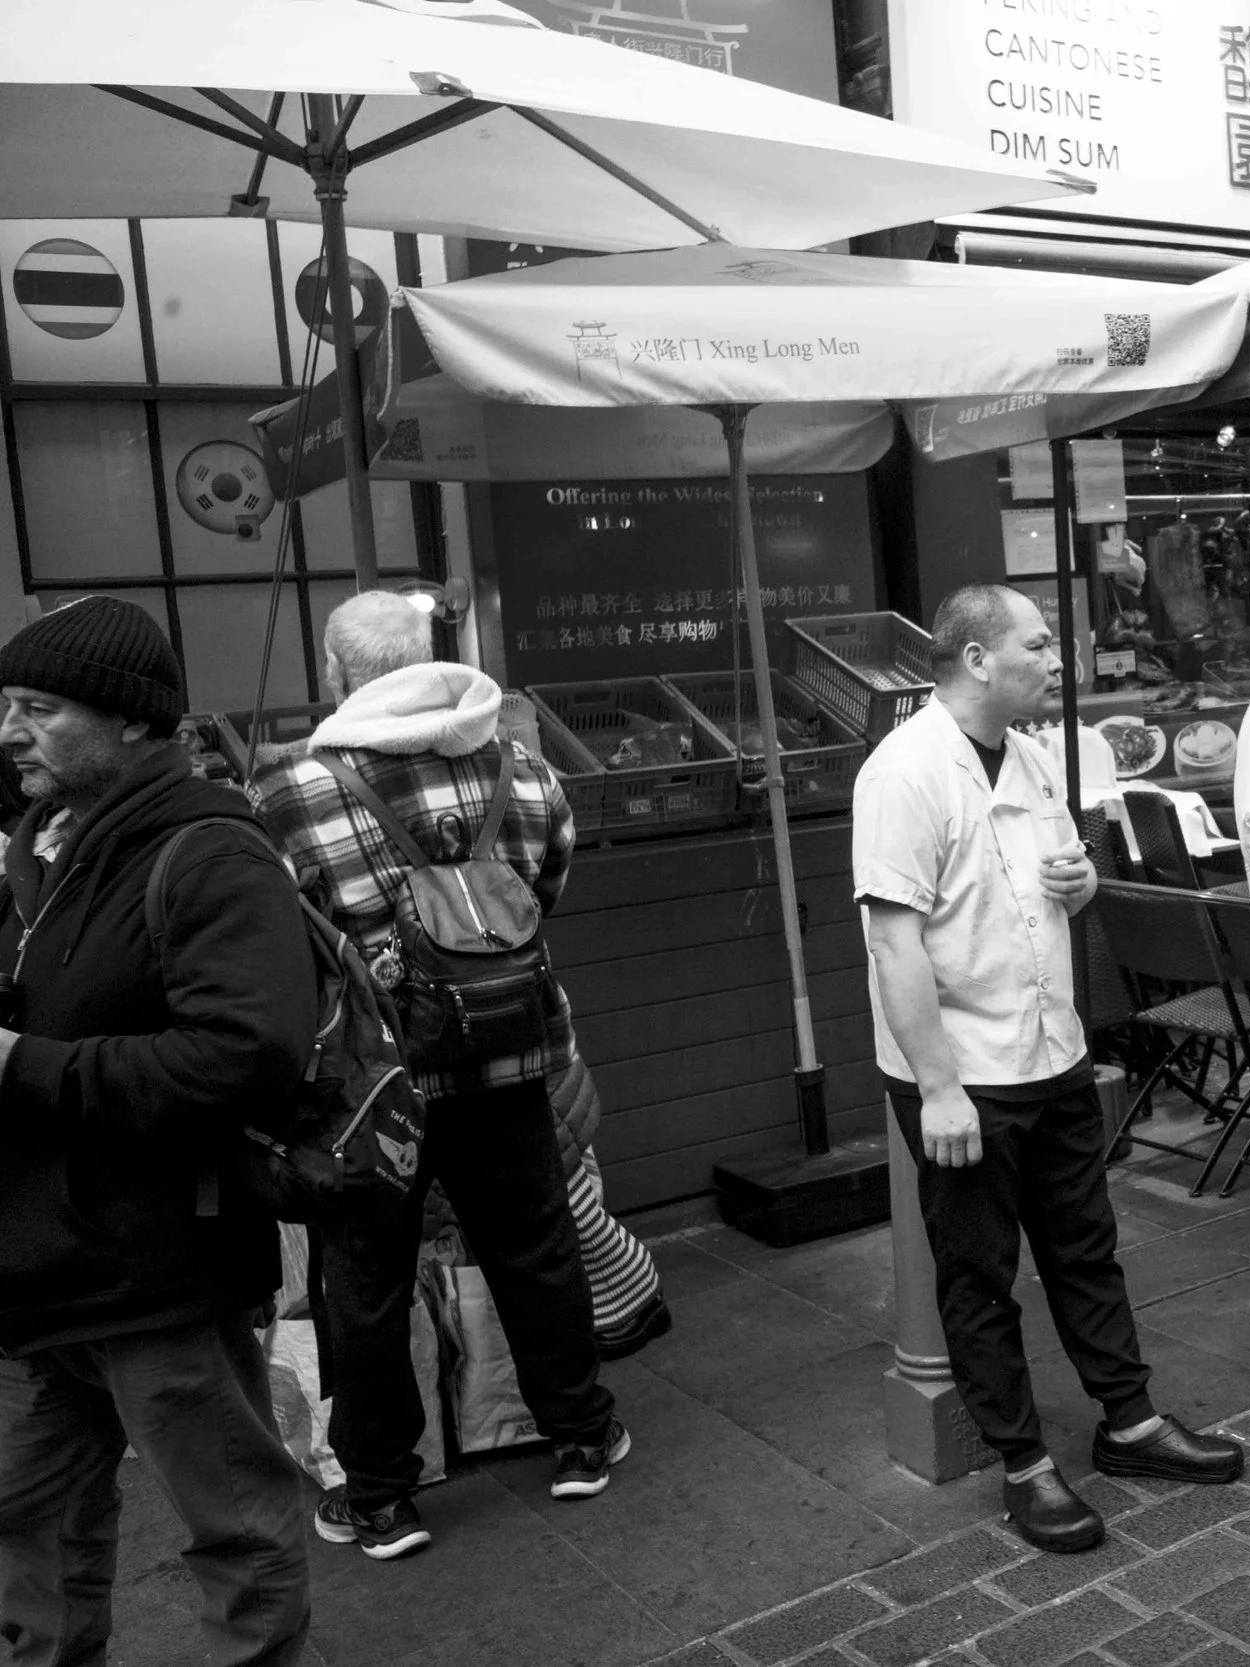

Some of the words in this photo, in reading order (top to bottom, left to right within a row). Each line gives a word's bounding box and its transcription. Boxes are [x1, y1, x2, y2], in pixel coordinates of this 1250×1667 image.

[984, 0, 1090, 23] KING
[985, 28, 1162, 83] CANTONESE
[987, 79, 1102, 121] CUISINE
[989, 129, 1047, 163] DIM
[1058, 137, 1120, 171] SUM
[630, 337, 703, 362] 兴隆门
[709, 339, 759, 363] Xing
[762, 339, 812, 363] Long
[818, 337, 860, 355] Men
[546, 487, 633, 507] Offering
[638, 487, 669, 504] the
[673, 486, 733, 504] Wides
[390, 1109, 406, 1124] THE
[514, 1422, 538, 1439] AS
